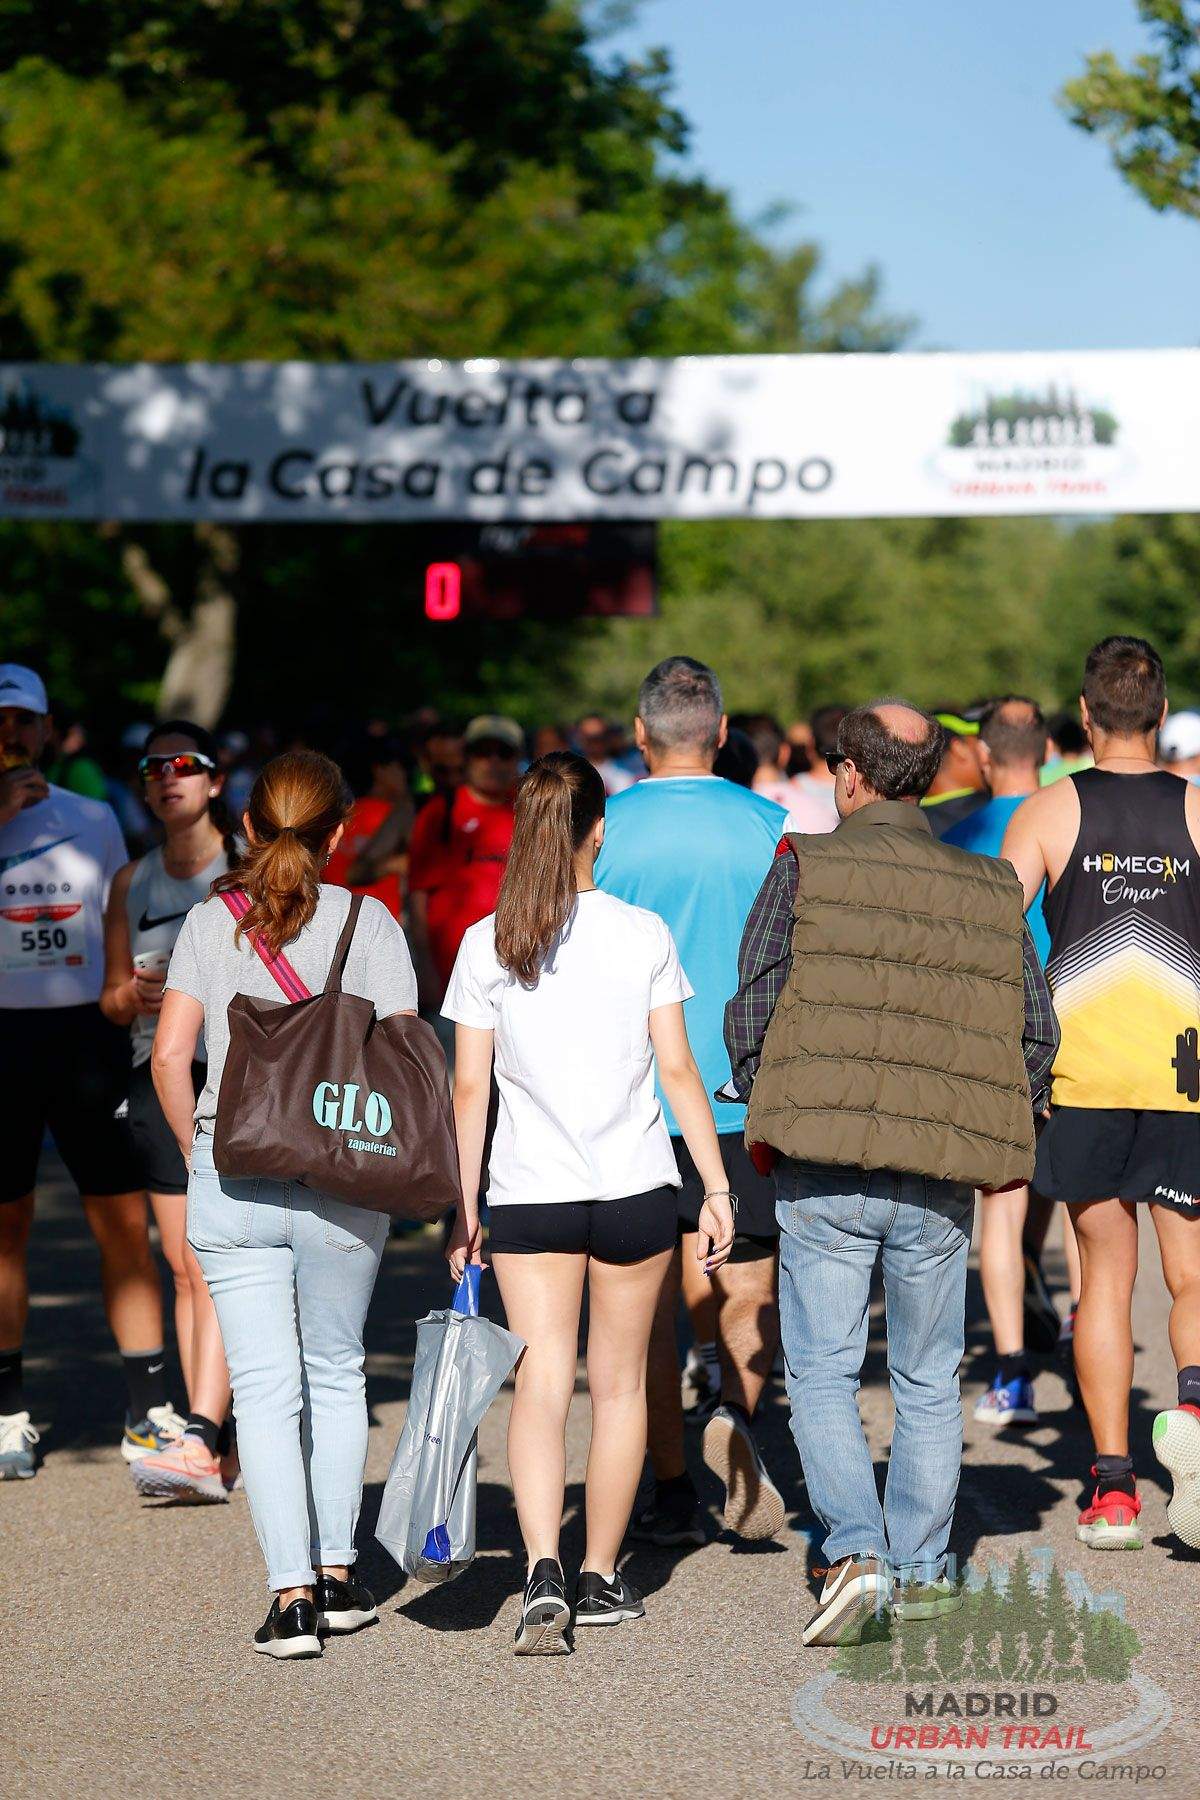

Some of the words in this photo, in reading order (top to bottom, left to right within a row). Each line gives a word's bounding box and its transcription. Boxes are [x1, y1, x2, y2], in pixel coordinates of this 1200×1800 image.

[361, 377, 588, 426] Vuelta
[615, 389, 656, 426] a
[185, 448, 249, 500] la
[269, 449, 443, 500] Casa
[469, 447, 553, 499] de
[583, 449, 834, 512] Campo
[425, 561, 461, 620] 0
[1102, 875, 1168, 905] Omar
[21, 928, 67, 952] 550
[312, 1081, 393, 1137] GLO
